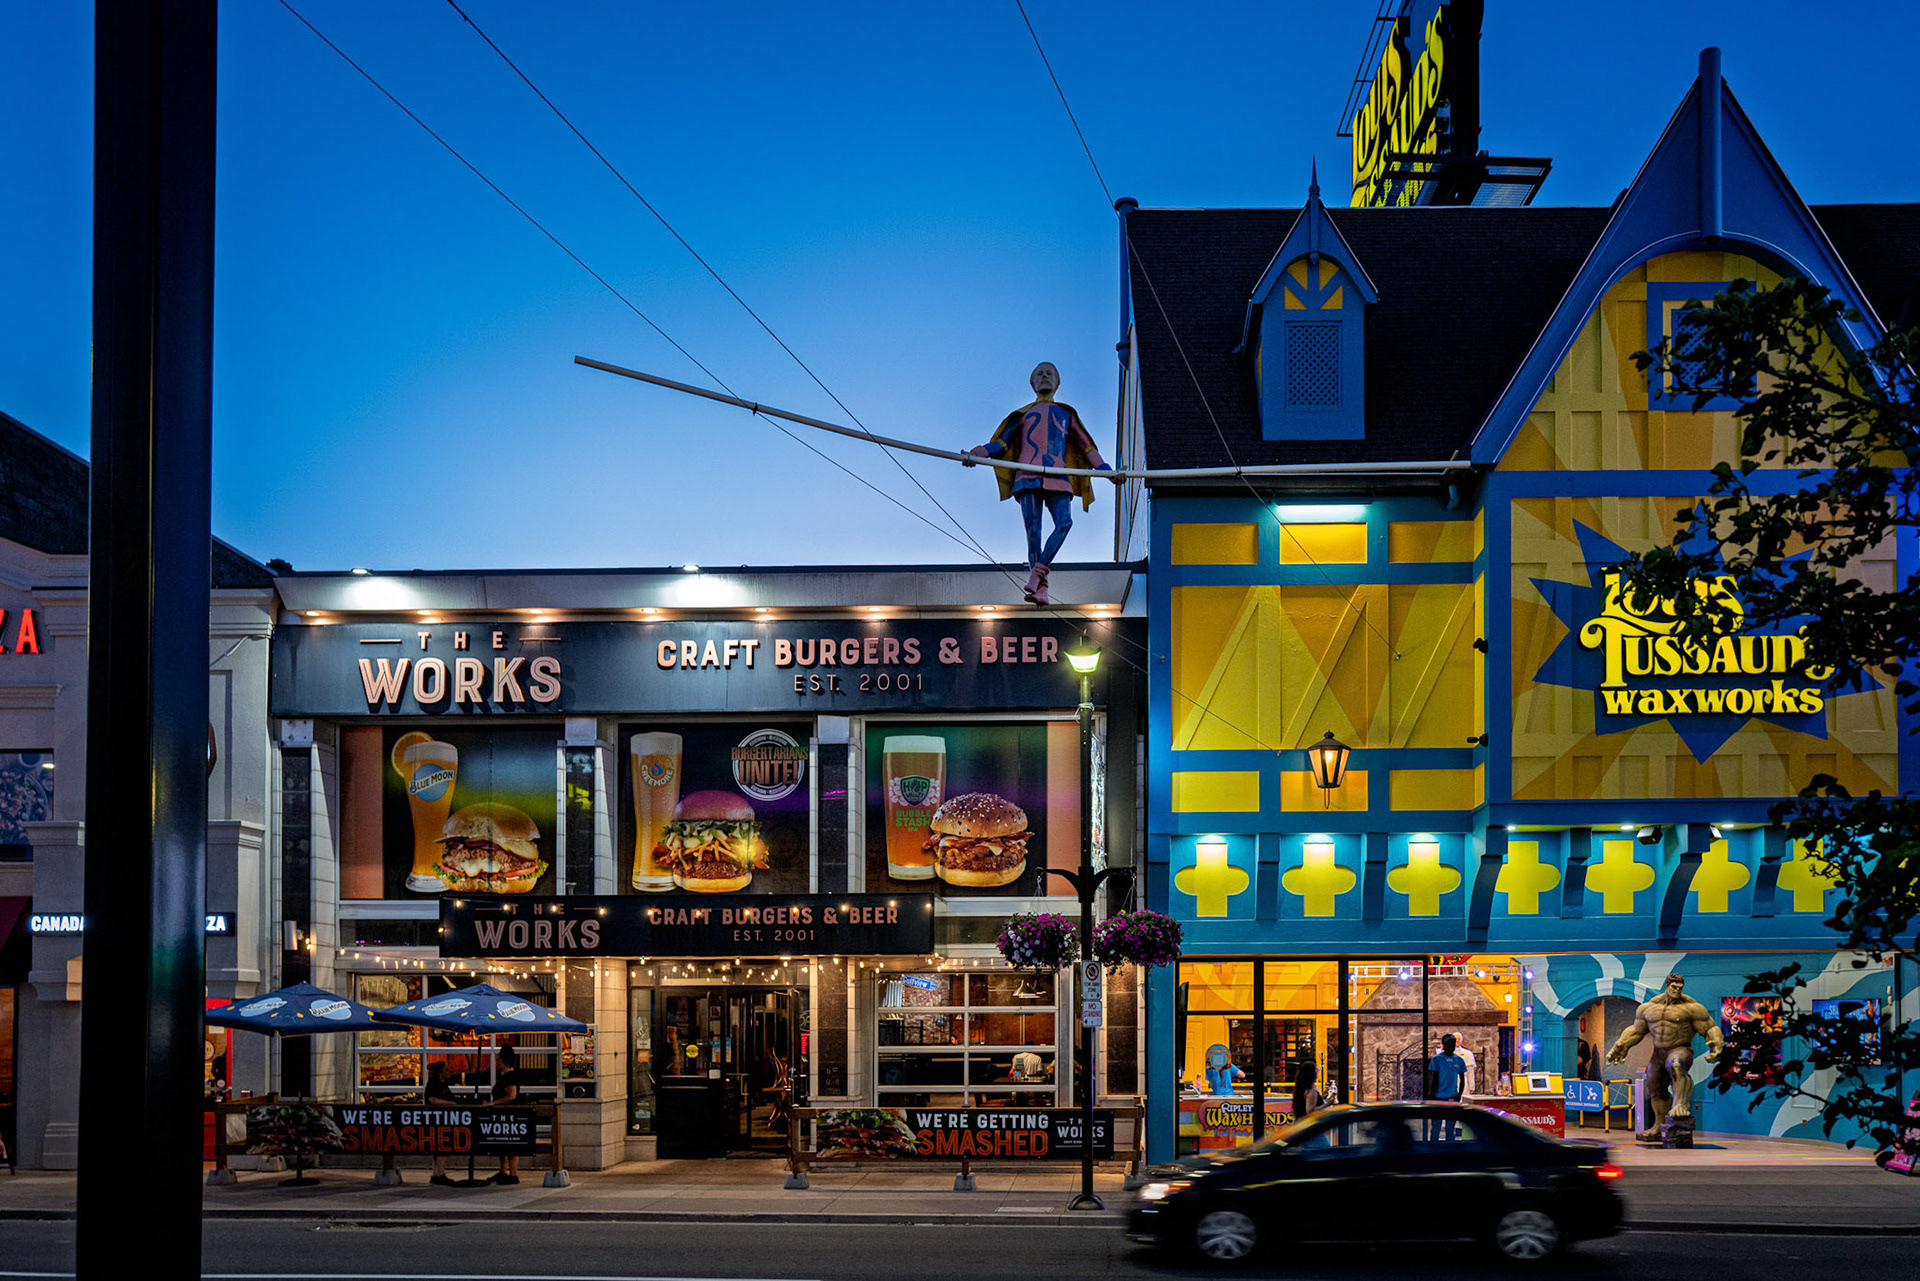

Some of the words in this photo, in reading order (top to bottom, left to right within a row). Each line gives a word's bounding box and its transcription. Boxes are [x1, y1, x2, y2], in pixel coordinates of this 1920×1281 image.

[416, 631, 504, 650] THE
[657, 639, 761, 668] CRAFT
[774, 637, 922, 667] BURGERS
[937, 637, 963, 665] &
[980, 635, 1059, 664] BEER
[358, 656, 562, 704] WORKS
[793, 674, 841, 692] EST.
[858, 672, 924, 692] 2001
[1600, 679, 1825, 715] waxworks
[731, 746, 809, 760] BURGERTARIANS
[431, 770, 453, 785] MOON
[641, 764, 674, 787] CREEMORE
[738, 760, 799, 785] UNITE!
[895, 809, 932, 818] BUBBLE
[895, 817, 932, 827] STASH
[511, 904, 566, 916] THE
[649, 907, 715, 926] CRAFT
[721, 907, 816, 926] BURGERS
[823, 907, 839, 925] &
[848, 906, 899, 925] BEER
[474, 918, 601, 950] WORKS
[733, 930, 768, 943] EST.
[773, 930, 815, 943] 2001
[1087, 1002, 1097, 1010] NO
[342, 1109, 393, 1127] WE'RE
[401, 1109, 473, 1127] GETTING
[491, 1114, 515, 1122] THE
[916, 1113, 968, 1129] WE'RE
[976, 1113, 1049, 1129] GETTING
[1241, 1111, 1296, 1126] HNDS
[480, 1123, 528, 1135] WORKS
[344, 1126, 472, 1153] SMASHED
[918, 1129, 1049, 1157] SMASHED
